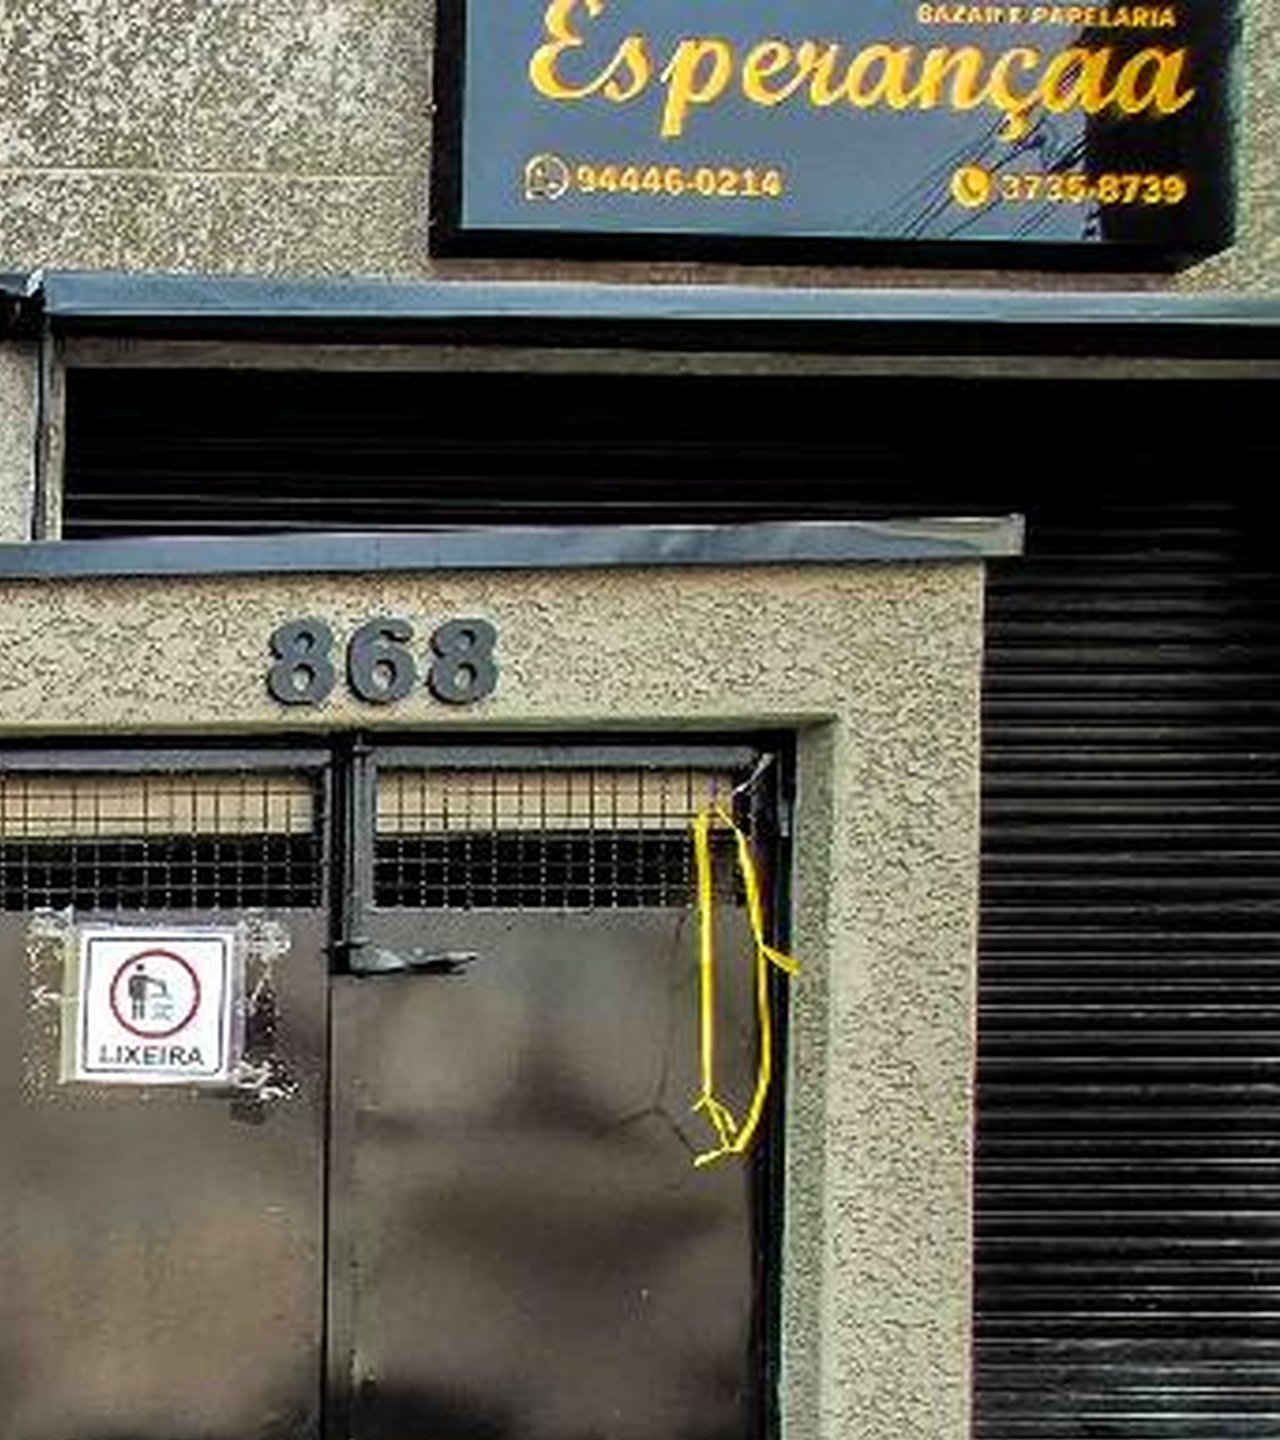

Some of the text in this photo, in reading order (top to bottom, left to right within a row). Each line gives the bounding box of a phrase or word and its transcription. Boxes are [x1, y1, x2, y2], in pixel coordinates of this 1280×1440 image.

[1030, 6, 1177, 27] PAPELARIA
[576, 164, 782, 197] 94446-0214
[266, 616, 500, 705] 868
[98, 1044, 206, 1067] LIXEIRA
